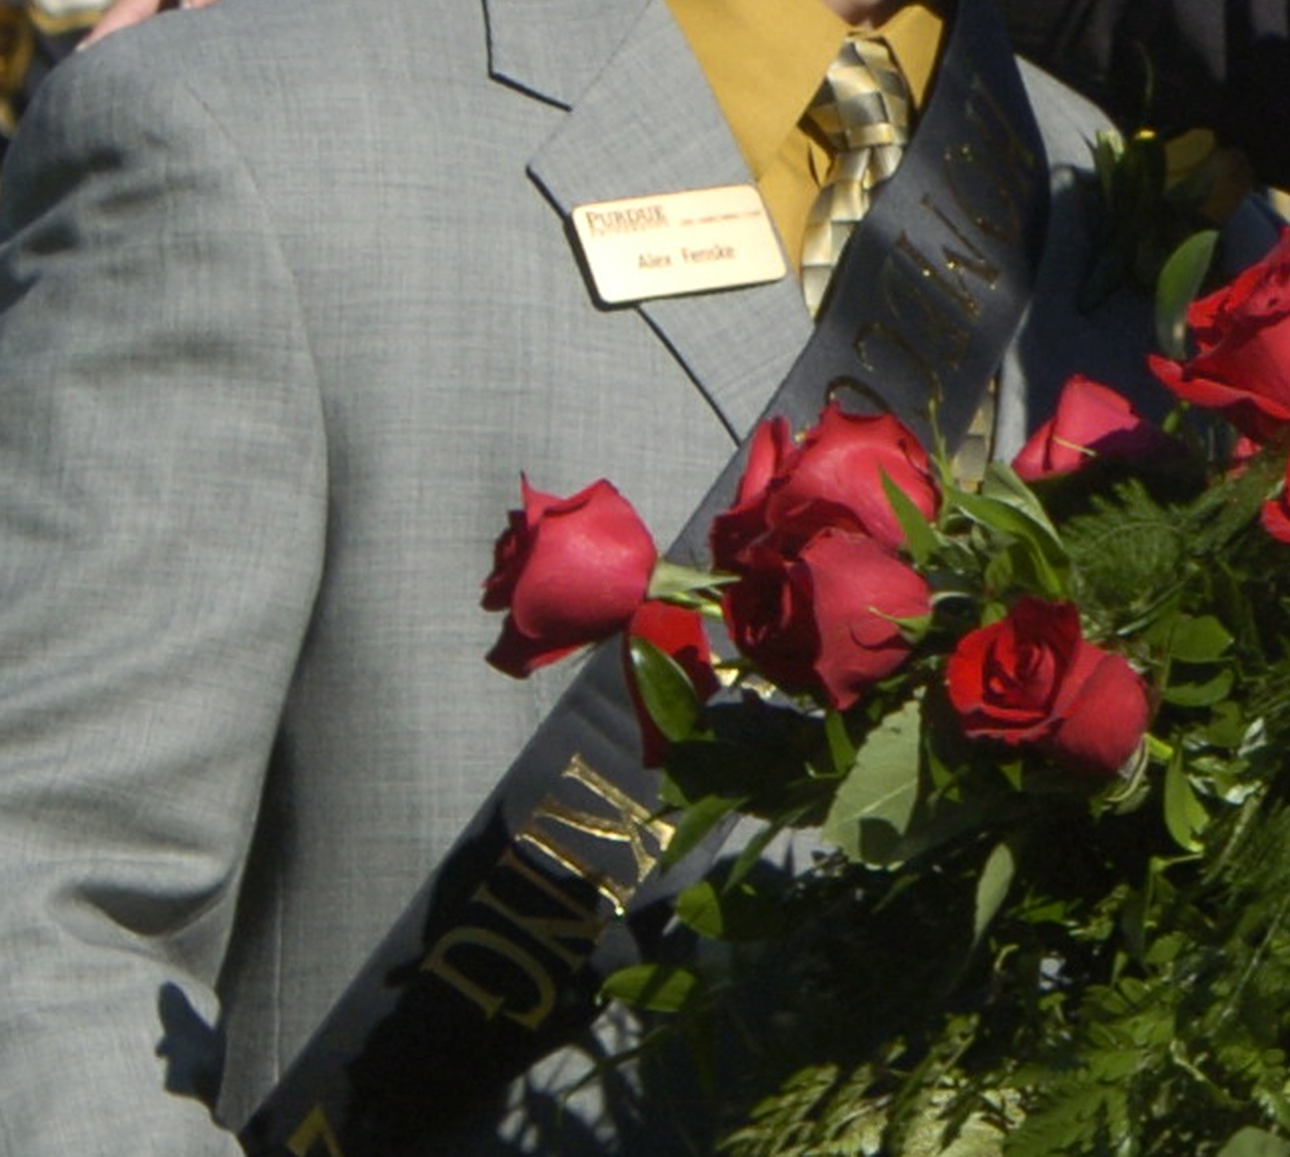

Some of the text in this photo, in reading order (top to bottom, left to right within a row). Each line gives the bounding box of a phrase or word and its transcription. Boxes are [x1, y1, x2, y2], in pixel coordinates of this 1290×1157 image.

[586, 205, 665, 230] PURDUE
[638, 244, 736, 269] Alex Fenske
[418, 752, 677, 1032] KING
